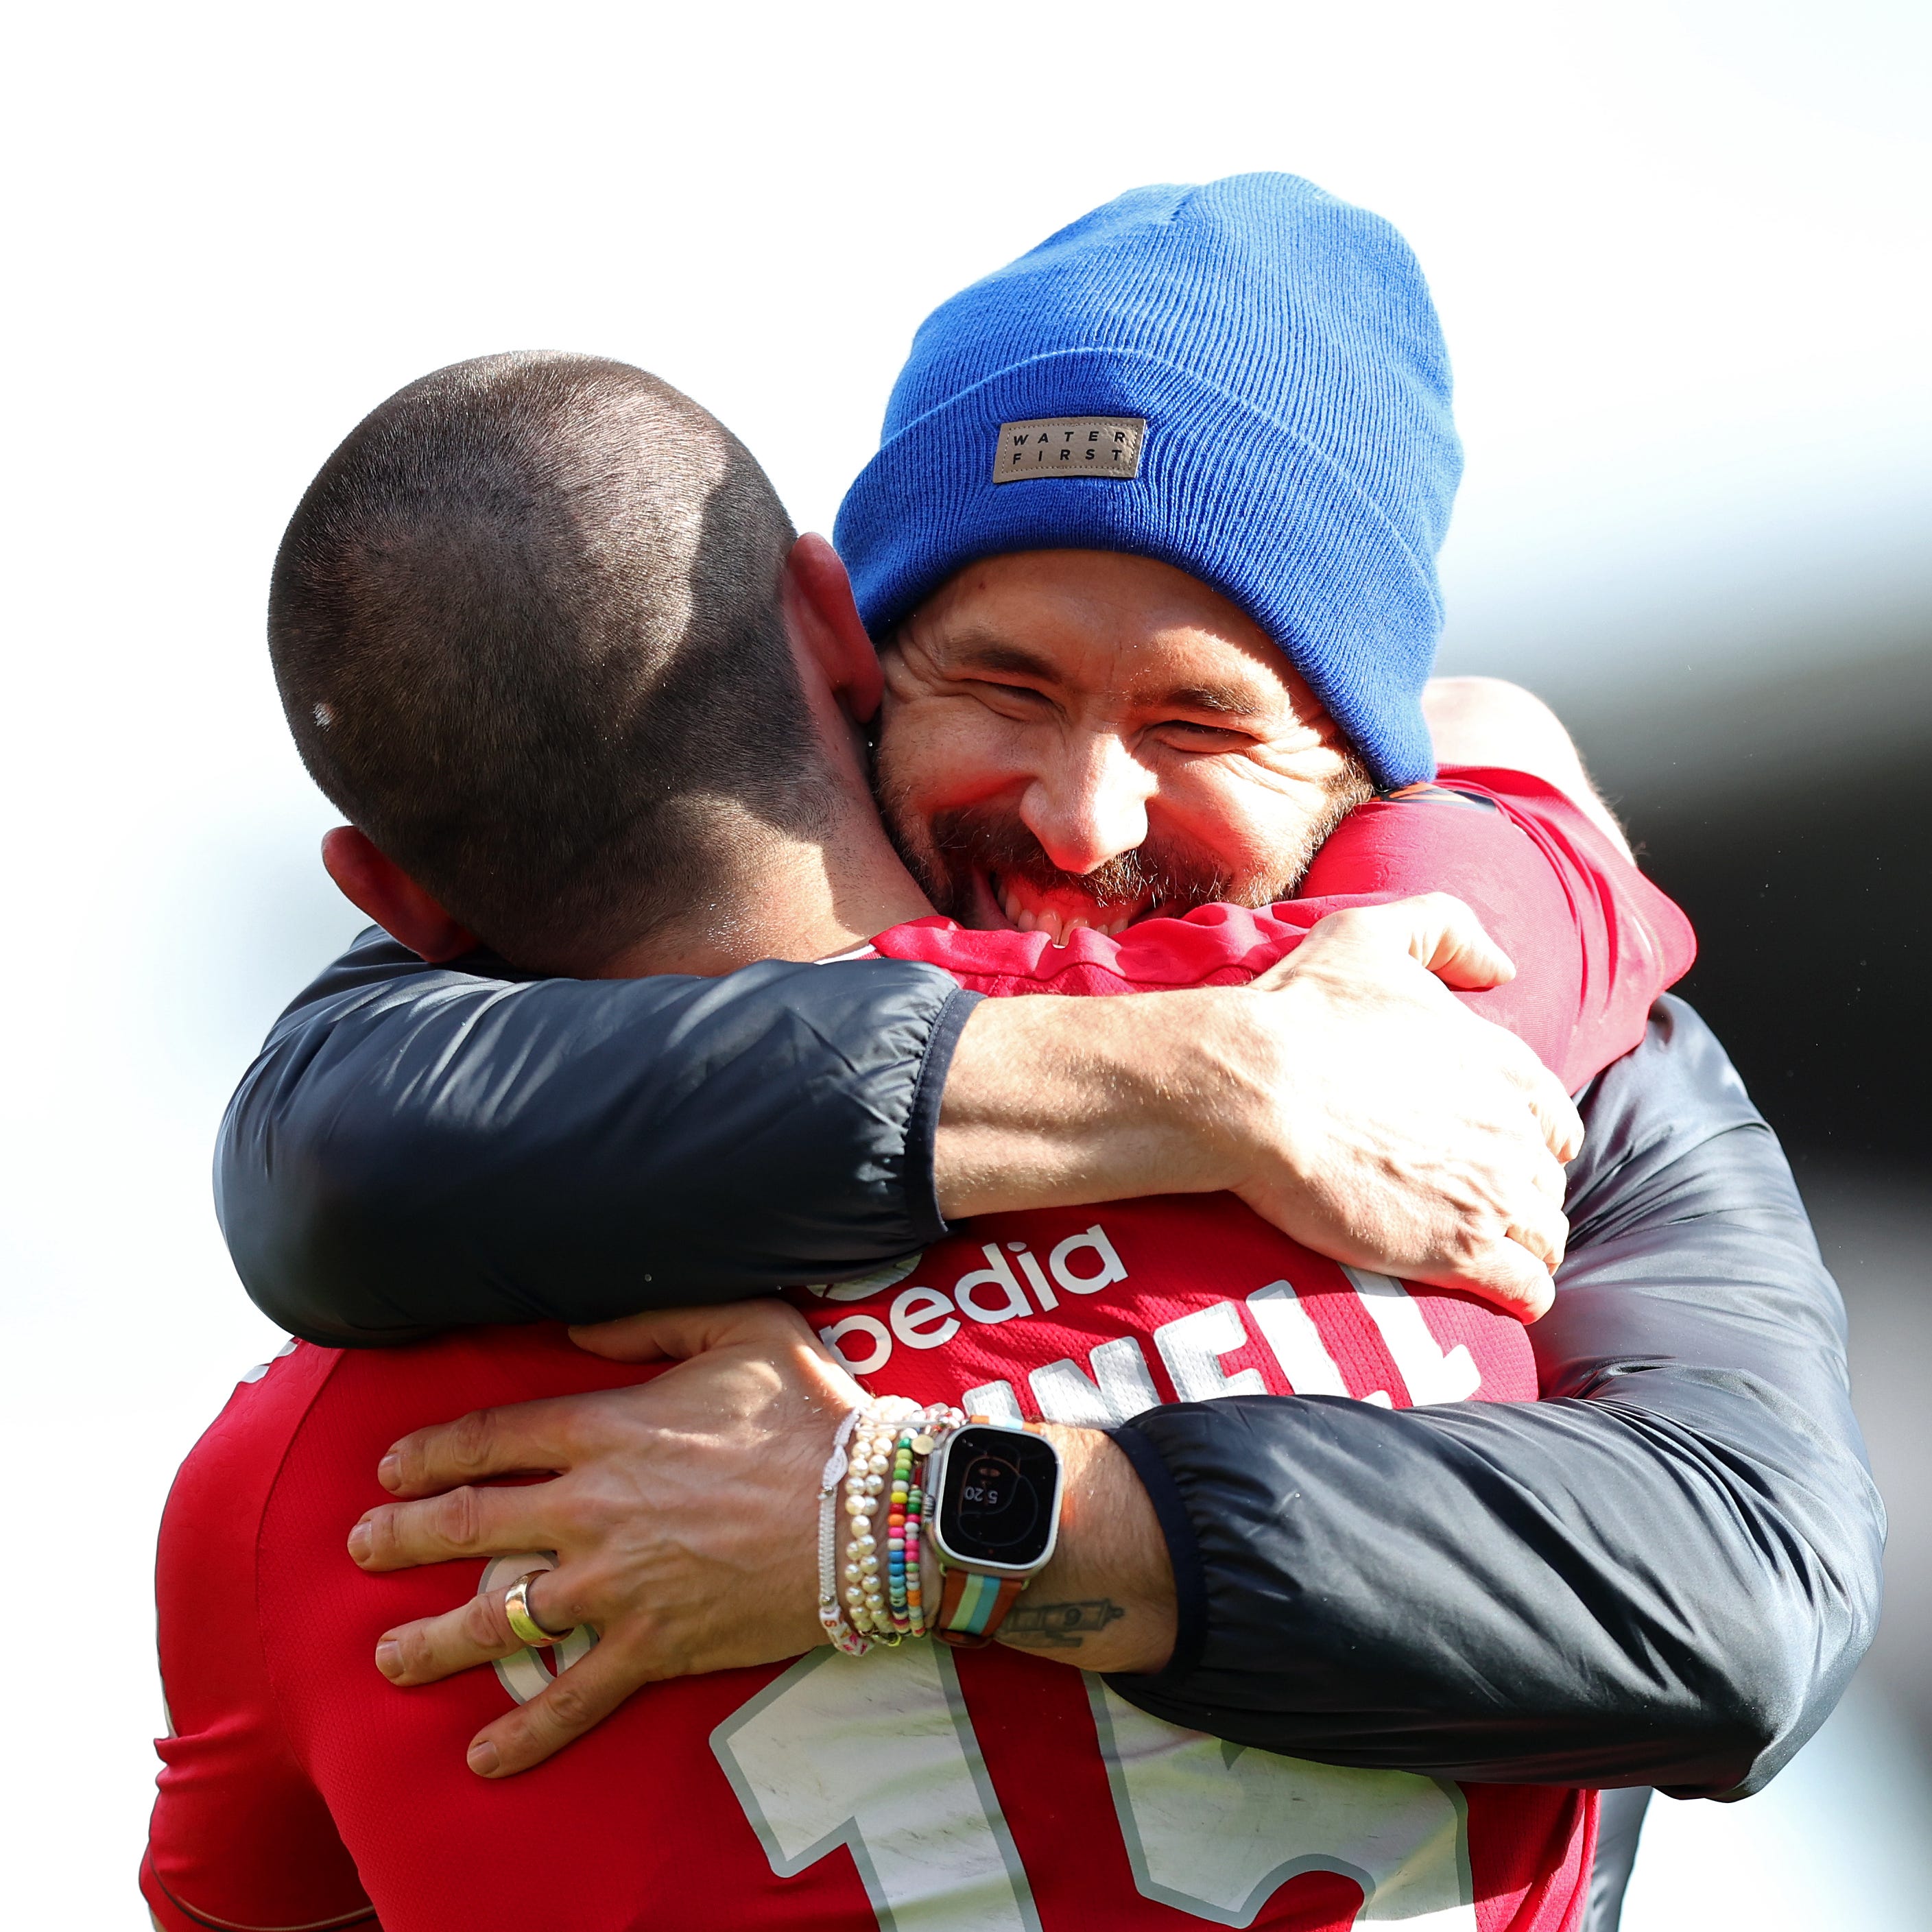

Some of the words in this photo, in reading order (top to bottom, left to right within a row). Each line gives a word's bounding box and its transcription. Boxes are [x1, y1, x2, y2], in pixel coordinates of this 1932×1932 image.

[1014, 431, 1125, 446] WATER
[1012, 449, 1122, 464] FIRST
[962, 1262, 1481, 1431] NELL
